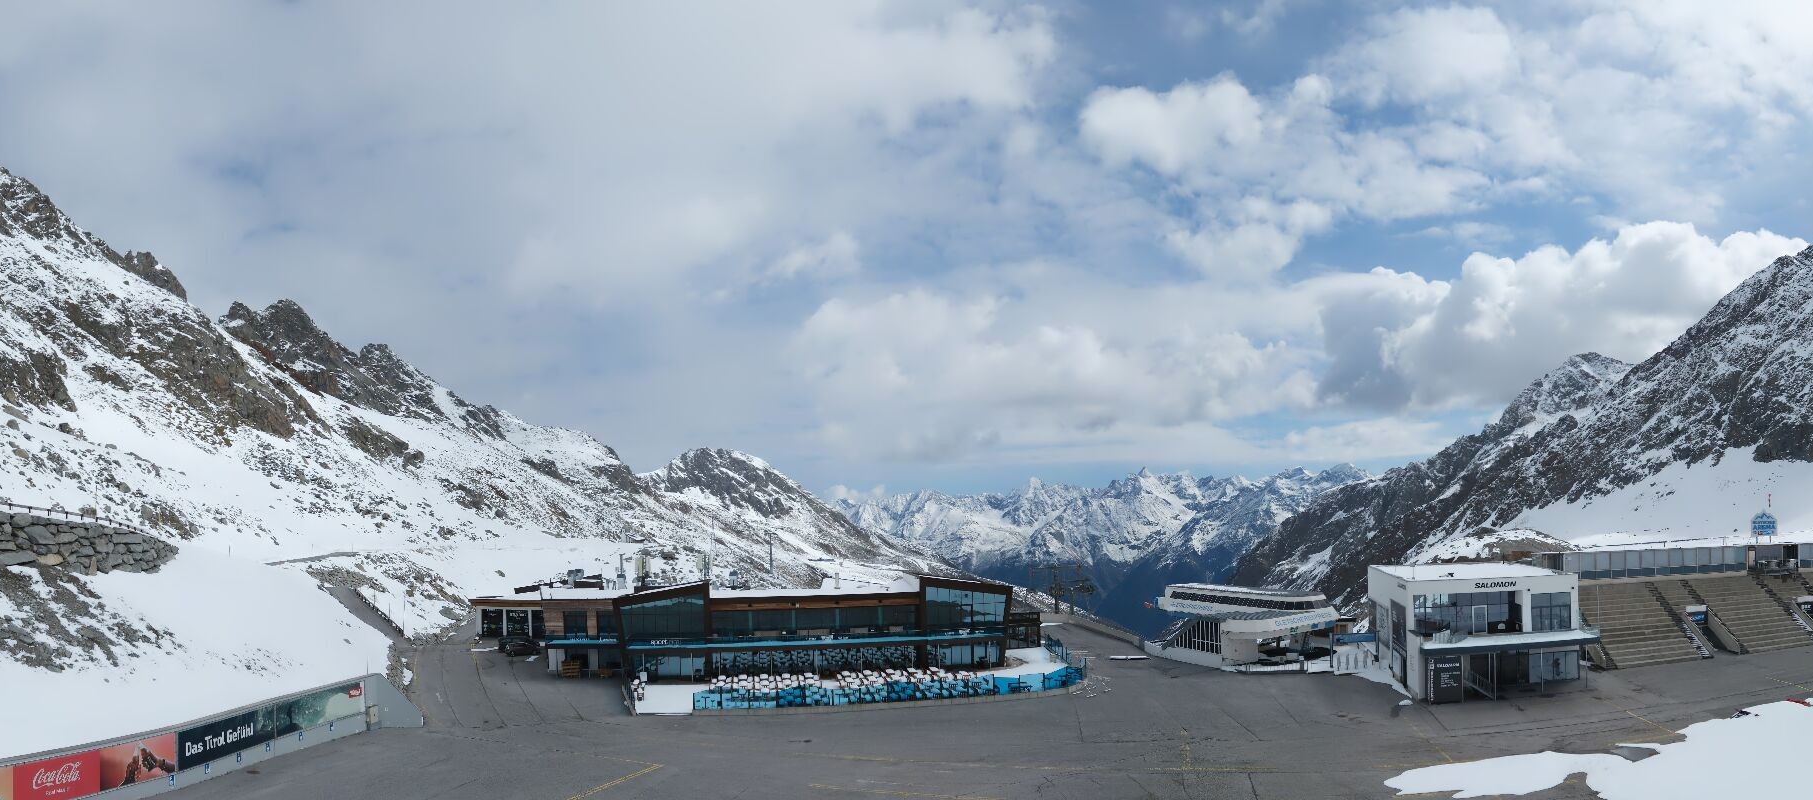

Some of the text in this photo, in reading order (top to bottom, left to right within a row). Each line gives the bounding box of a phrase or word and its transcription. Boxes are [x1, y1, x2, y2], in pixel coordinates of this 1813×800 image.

[1474, 580, 1517, 589] SALOMON
[185, 721, 254, 757] Das Tirol Gefühl
